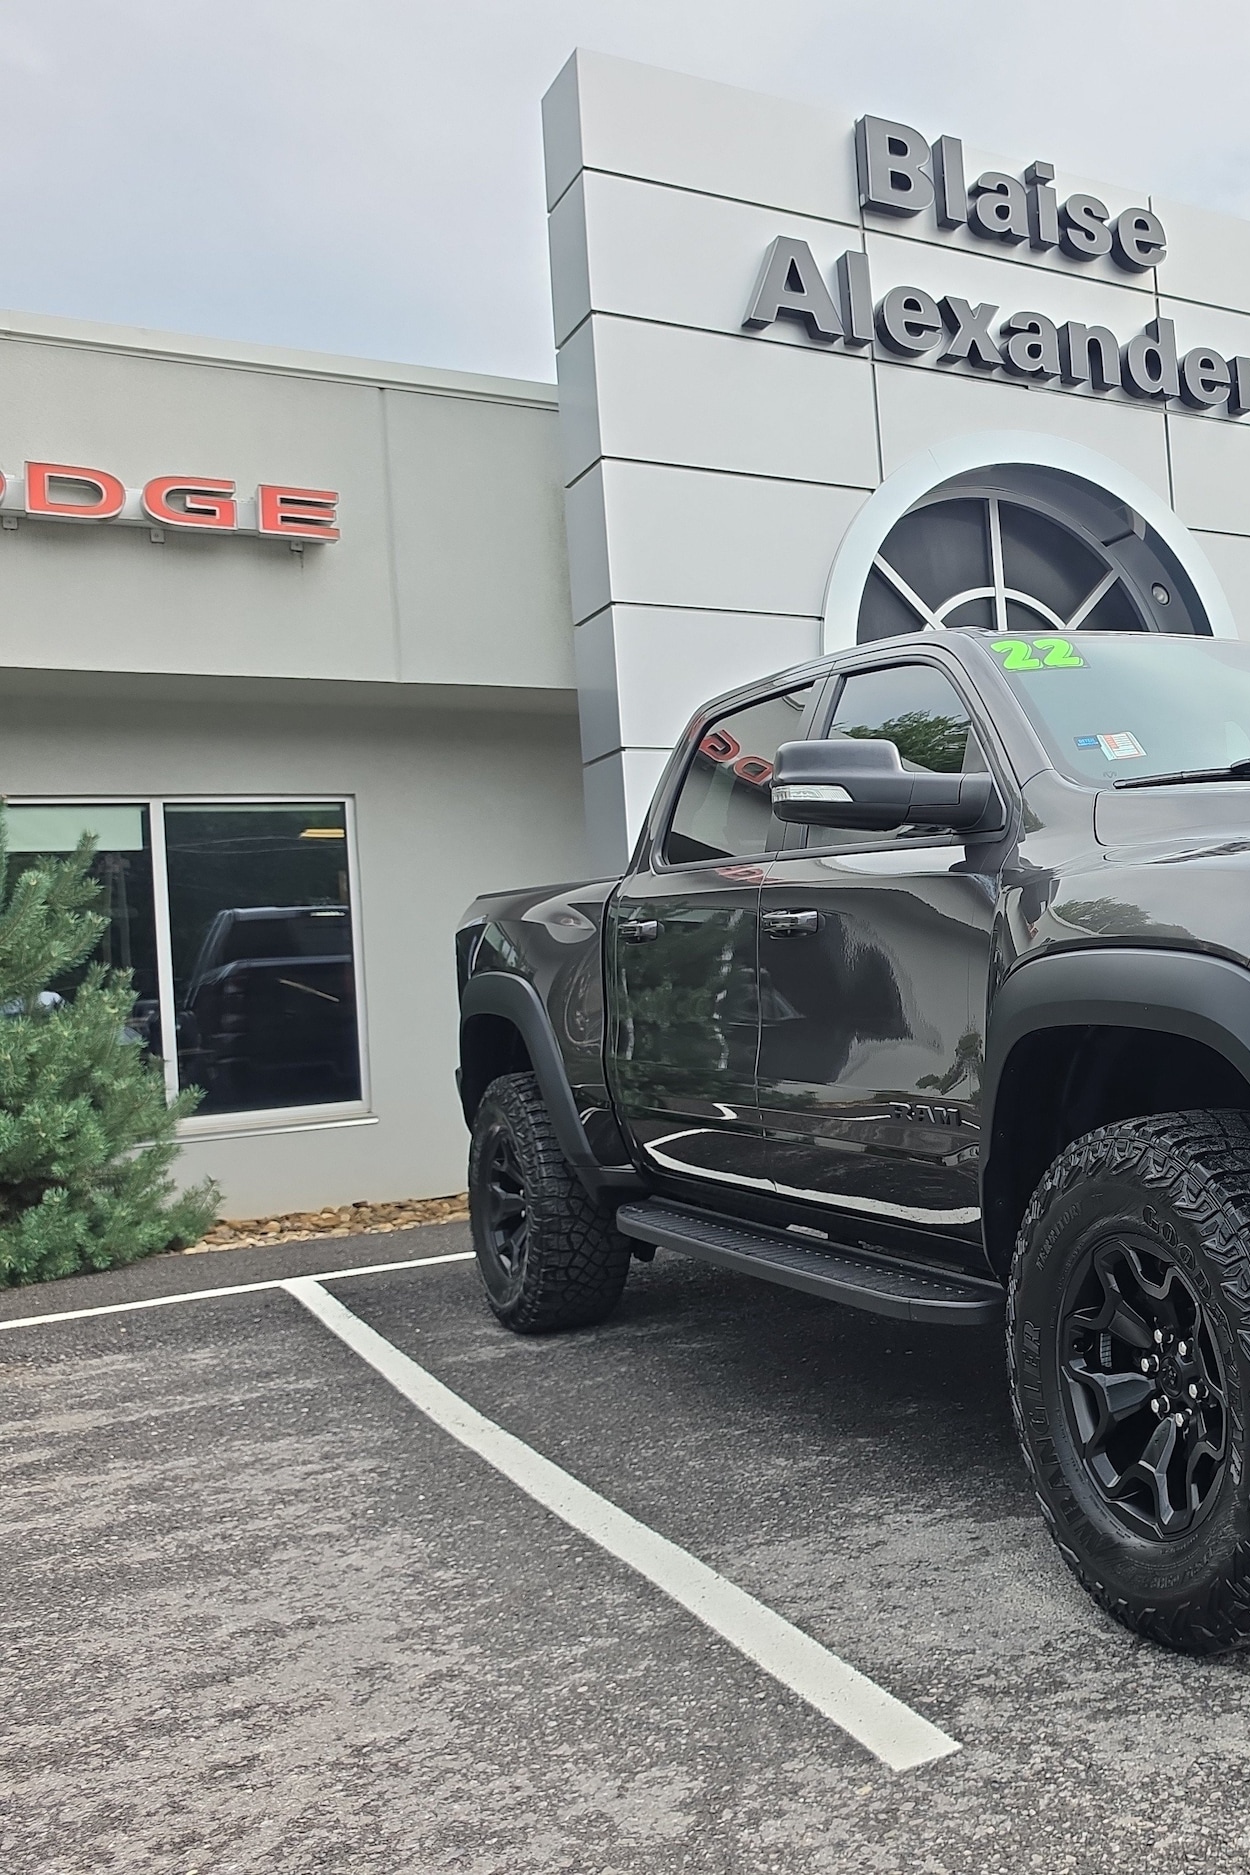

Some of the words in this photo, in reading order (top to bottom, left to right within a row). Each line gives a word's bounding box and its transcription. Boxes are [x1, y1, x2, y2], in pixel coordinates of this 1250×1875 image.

[855, 114, 1168, 273] Blaise
[0, 460, 341, 544] DGE
[990, 638, 1085, 672] 22
[888, 1101, 962, 1126] RAM
